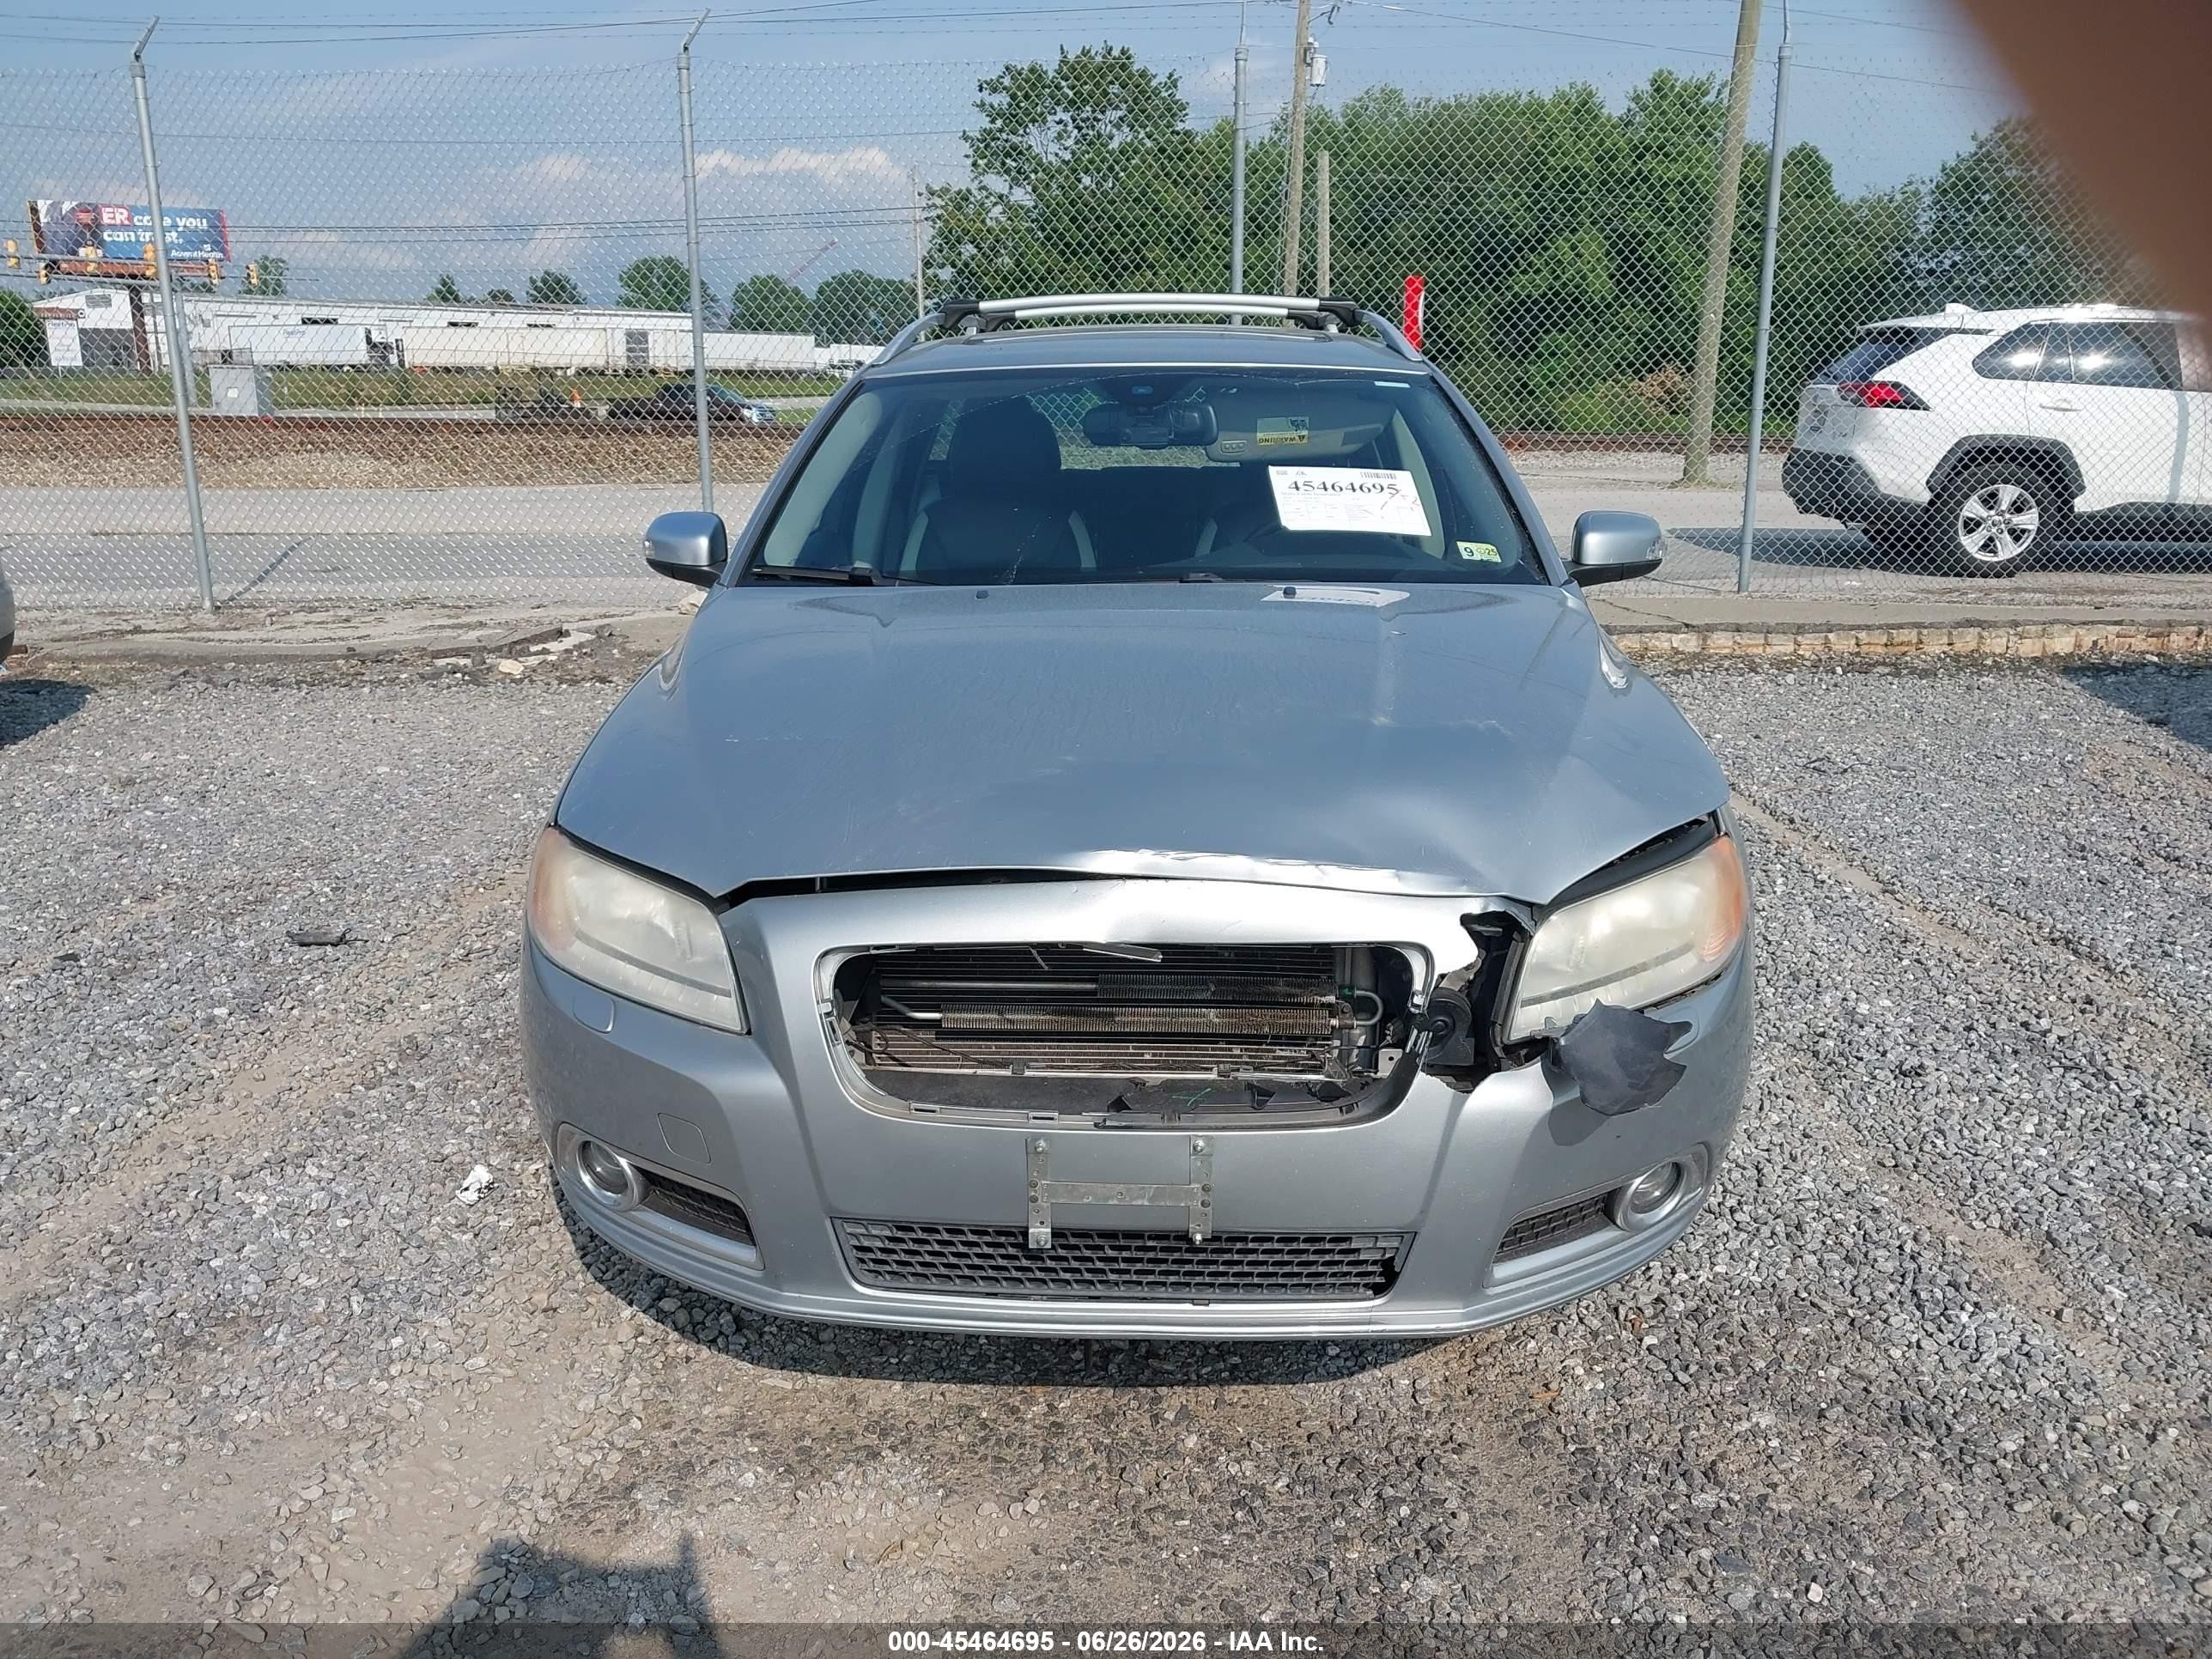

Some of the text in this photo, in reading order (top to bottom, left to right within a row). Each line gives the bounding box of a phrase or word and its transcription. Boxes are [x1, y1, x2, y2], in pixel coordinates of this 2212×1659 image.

[101, 207, 208, 231] ER cae you
[103, 231, 136, 242] can
[1288, 480, 1400, 495] 45464695
[1464, 547, 1498, 556] 9 25
